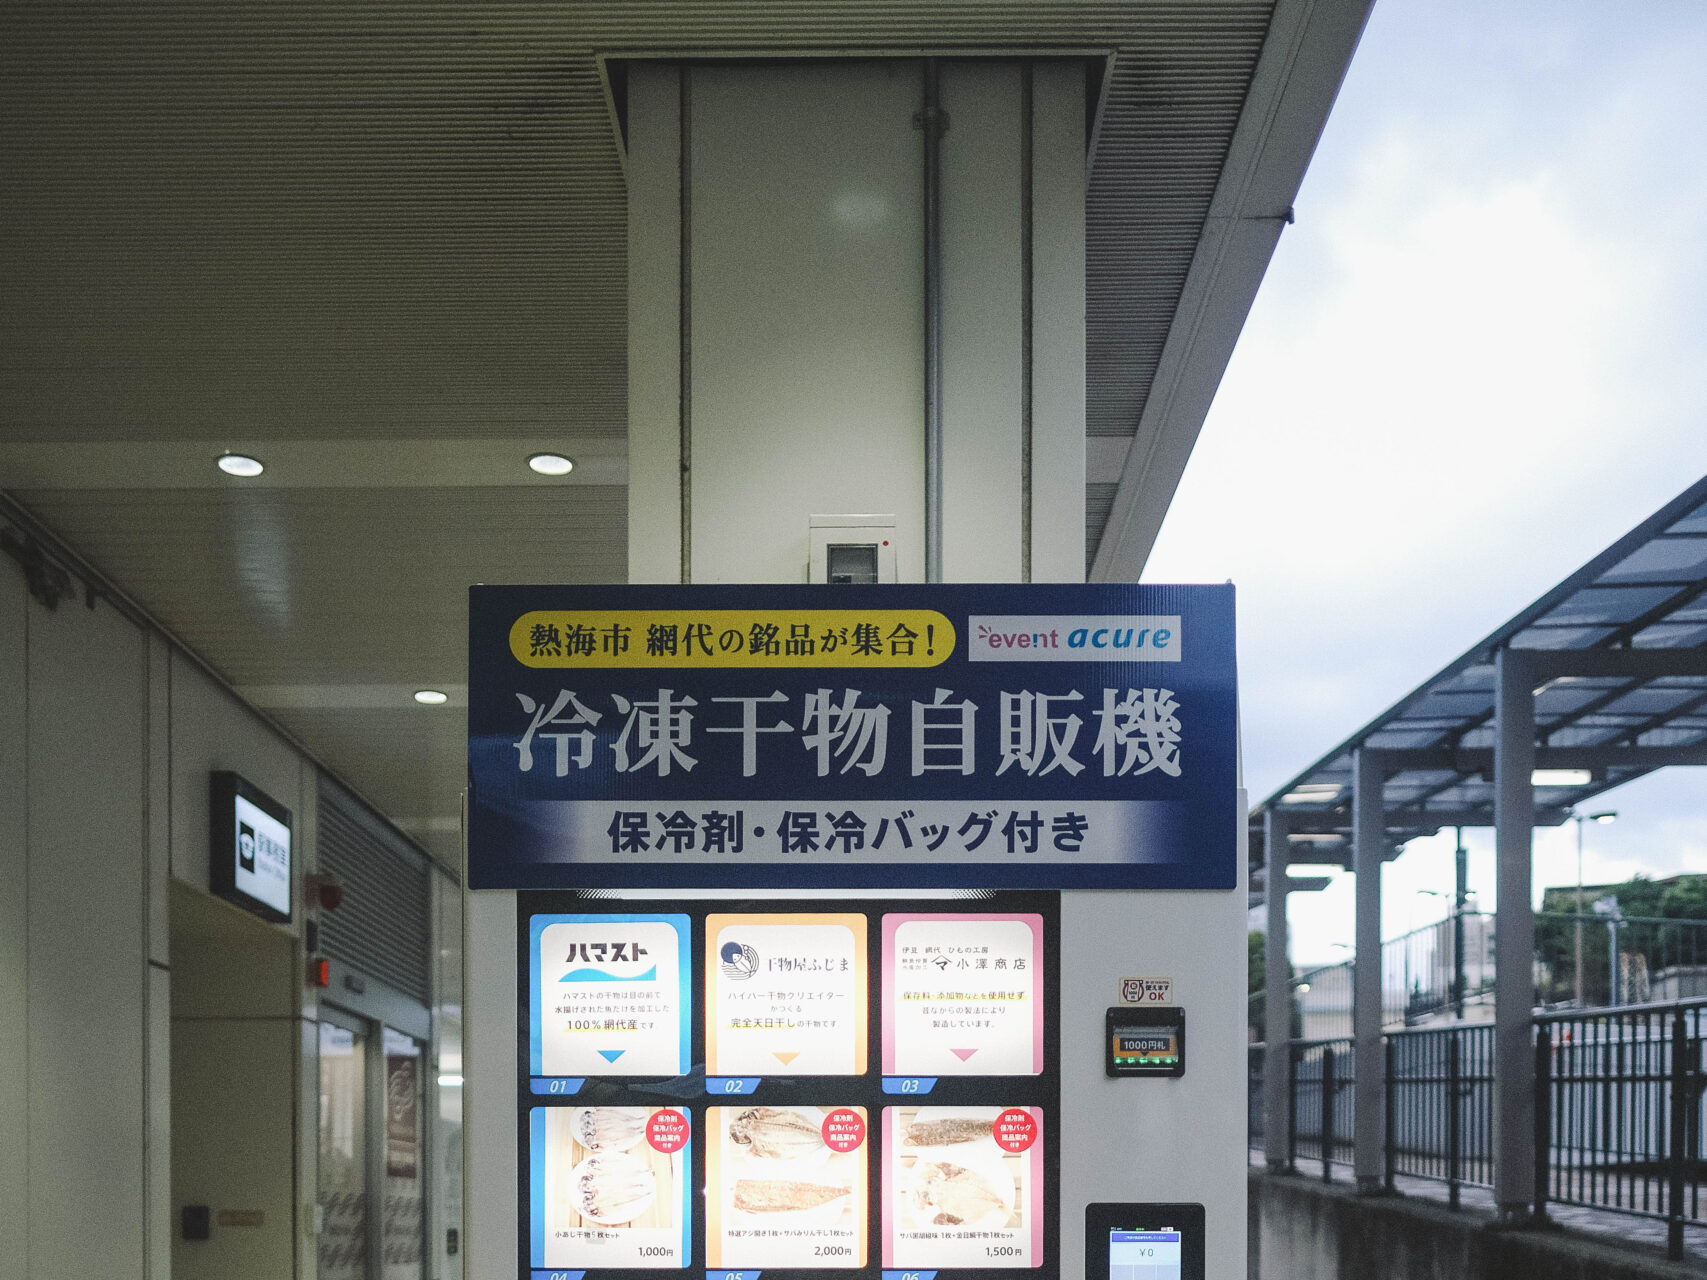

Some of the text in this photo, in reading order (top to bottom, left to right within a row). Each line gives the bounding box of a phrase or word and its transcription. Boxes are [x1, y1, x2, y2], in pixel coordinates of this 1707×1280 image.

[530, 623, 633, 656] 熱海市
[988, 625, 1172, 650] event acure
[514, 689, 1182, 777] 冷凍干物自販機
[607, 810, 1090, 855] 保冷剤・保冷バッグ付き
[566, 943, 648, 962] ハマスト
[1149, 992, 1165, 1001] OK
[1124, 1041, 1166, 1050] 1000円札
[549, 1080, 567, 1093] 01
[725, 1080, 743, 1093] 02
[902, 1080, 919, 1093] 03
[653, 1124, 684, 1132] 保冷バッグ
[828, 1124, 860, 1132] 保冷バッグ
[1000, 1124, 1032, 1132] 保冷バッグ
[638, 1247, 674, 1257] 1,000円
[814, 1246, 852, 1256] 2,000円
[986, 1247, 1022, 1256] 1,500円
